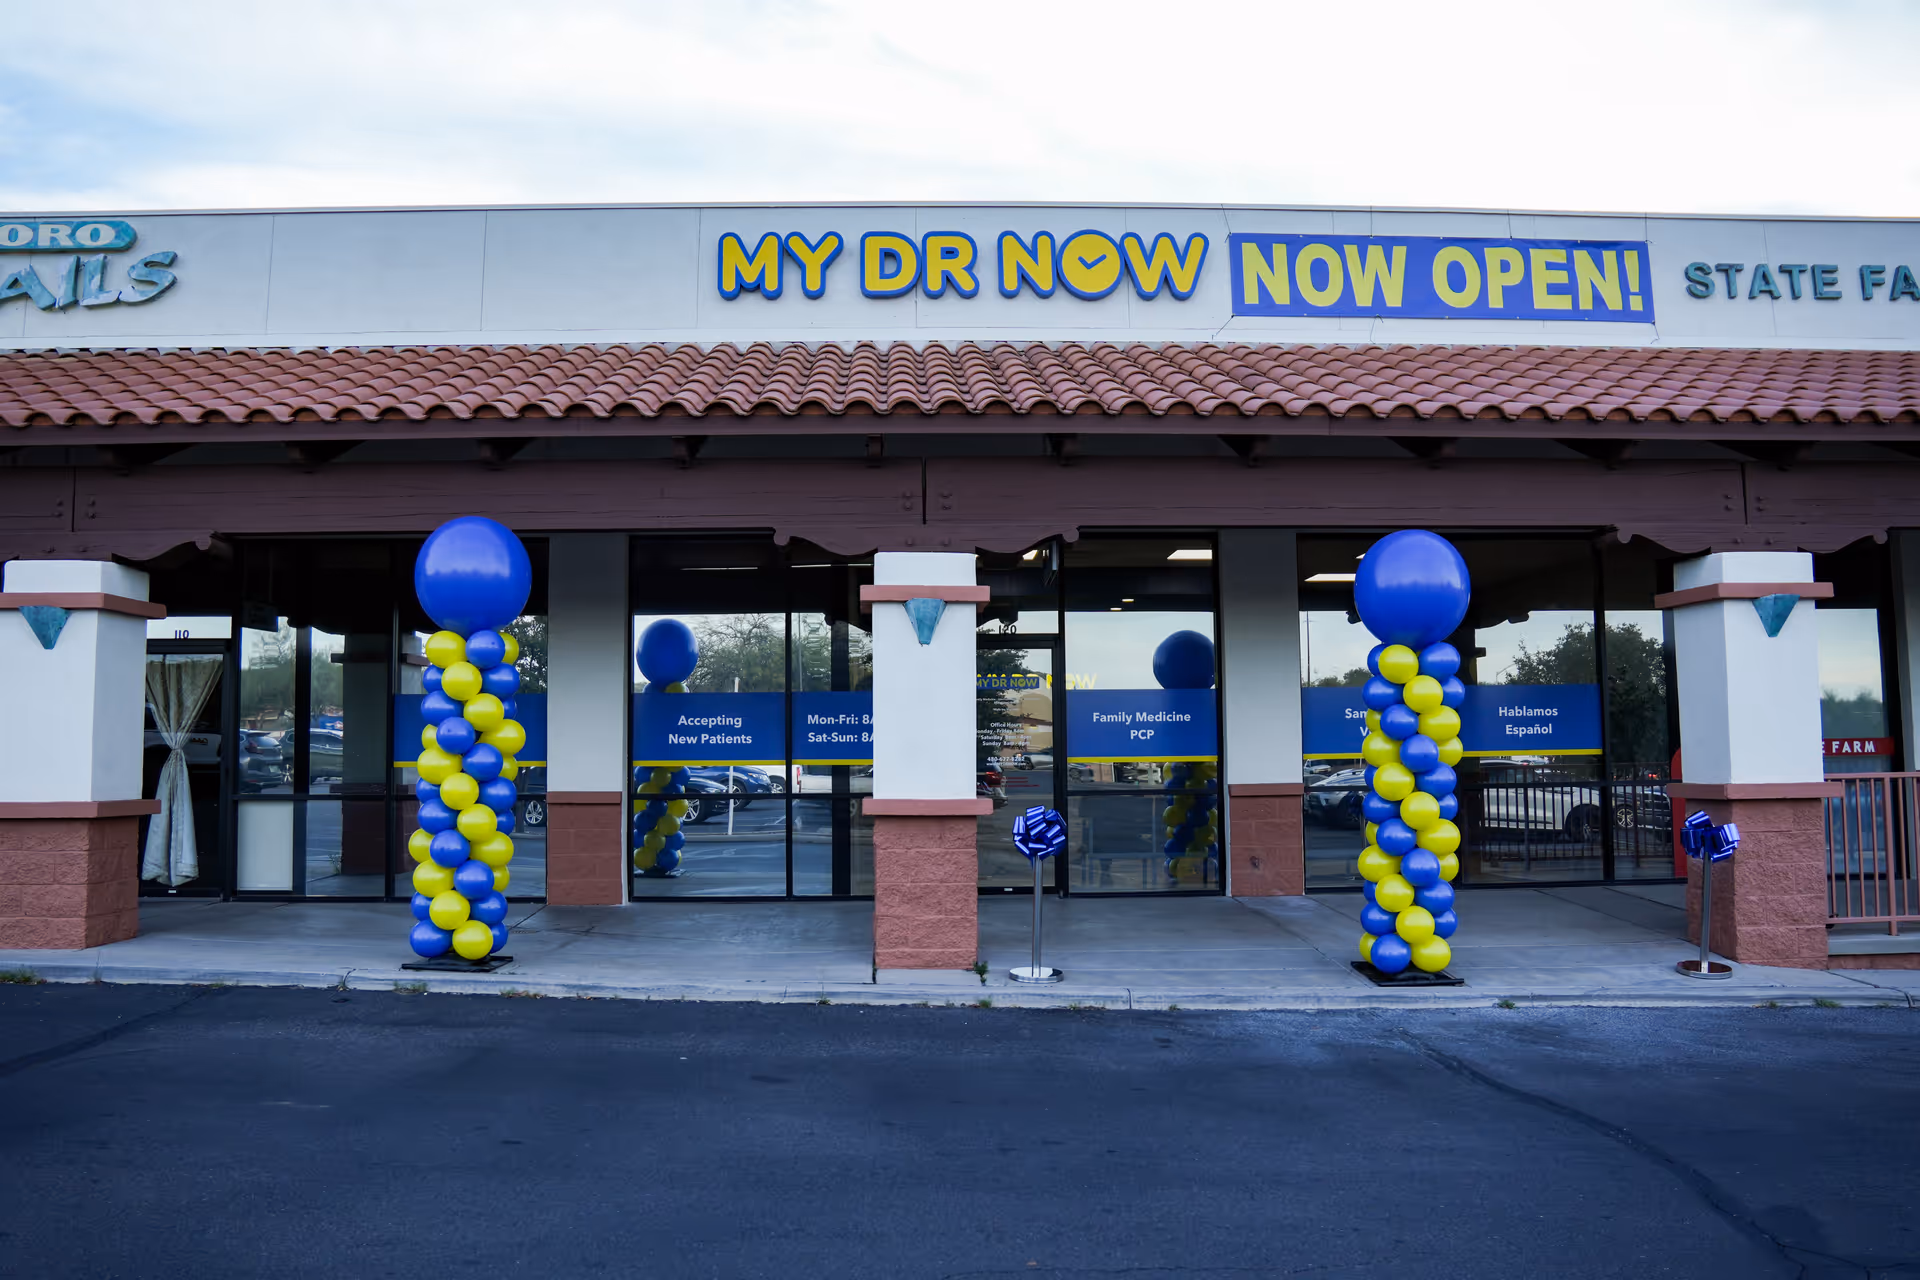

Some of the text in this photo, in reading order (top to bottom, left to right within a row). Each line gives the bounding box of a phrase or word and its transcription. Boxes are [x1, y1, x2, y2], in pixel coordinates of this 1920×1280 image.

[717, 229, 1209, 300] MY DR NOW
[1240, 242, 1644, 312] NOW OPEN!
[1684, 262, 1920, 302] STATE FA
[174, 629, 190, 640] 110
[998, 624, 1017, 635] 120
[992, 678, 1007, 688] DR
[1010, 678, 1038, 687] NOW
[1498, 706, 1558, 717] Hablamos
[677, 715, 742, 728] Accepting
[807, 714, 859, 725] Mon-Fri:
[1092, 711, 1191, 726] Family Medicine
[1130, 729, 1155, 740] PCP
[1505, 724, 1553, 737] Español
[668, 733, 753, 745] New Patients
[808, 732, 858, 743] Sat-Sun:
[1831, 740, 1876, 753] FARM
